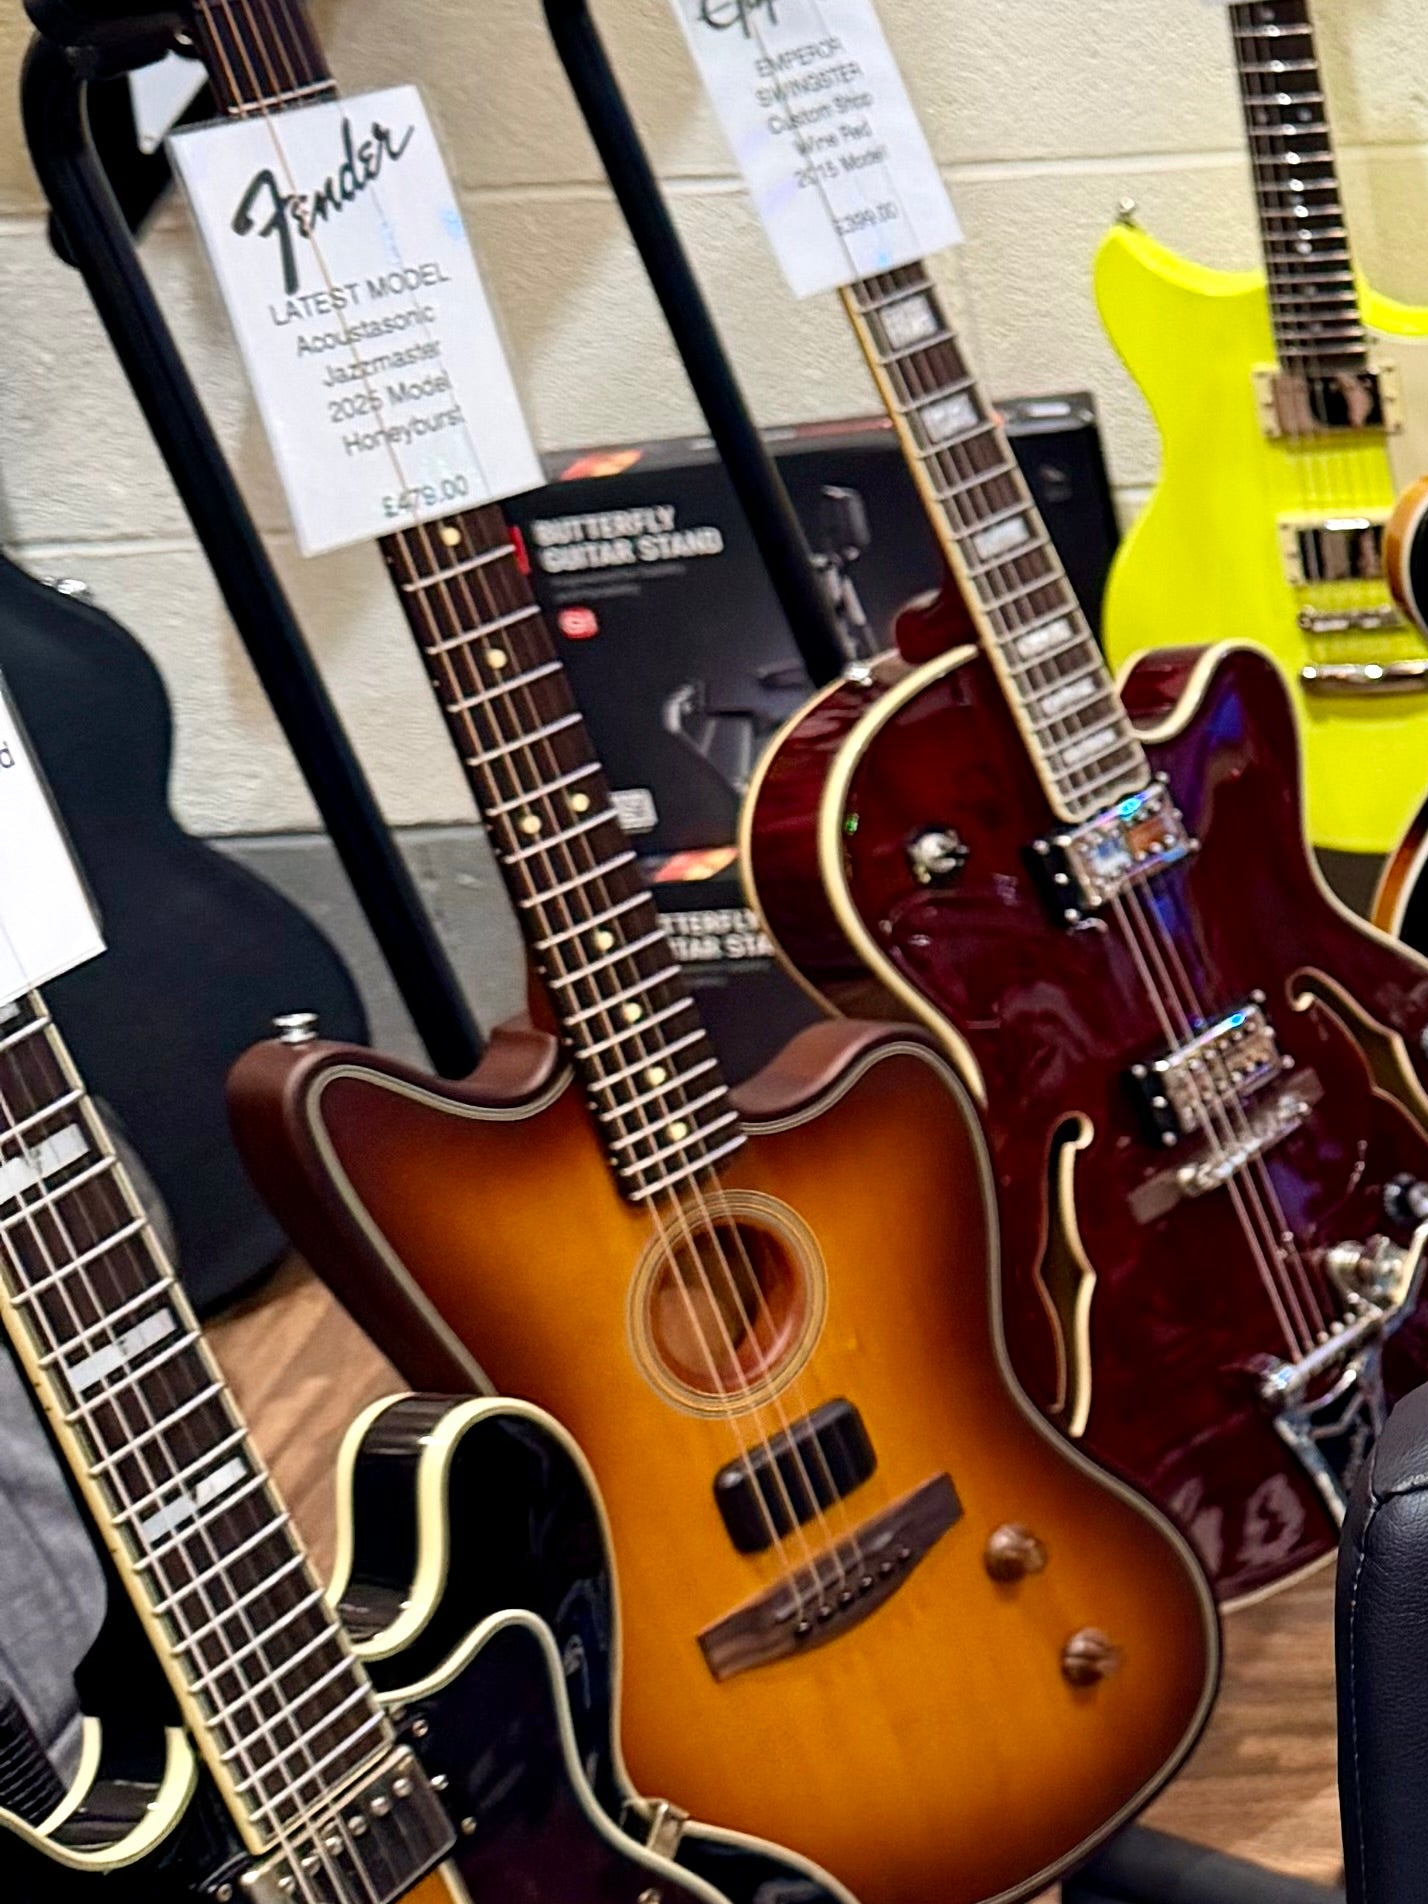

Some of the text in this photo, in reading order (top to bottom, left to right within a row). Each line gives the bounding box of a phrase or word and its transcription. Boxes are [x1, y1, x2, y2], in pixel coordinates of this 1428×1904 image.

[231, 117, 415, 295] Fender
[270, 262, 449, 326] LATEST MODEL
[296, 303, 437, 357] Acoustasonic
[323, 339, 442, 388] Jazzmaster
[386, 369, 453, 407] Model
[342, 405, 465, 456] Honeyburst
[540, 526, 724, 573] GUITAR STAND
[720, 933, 775, 959] STA
